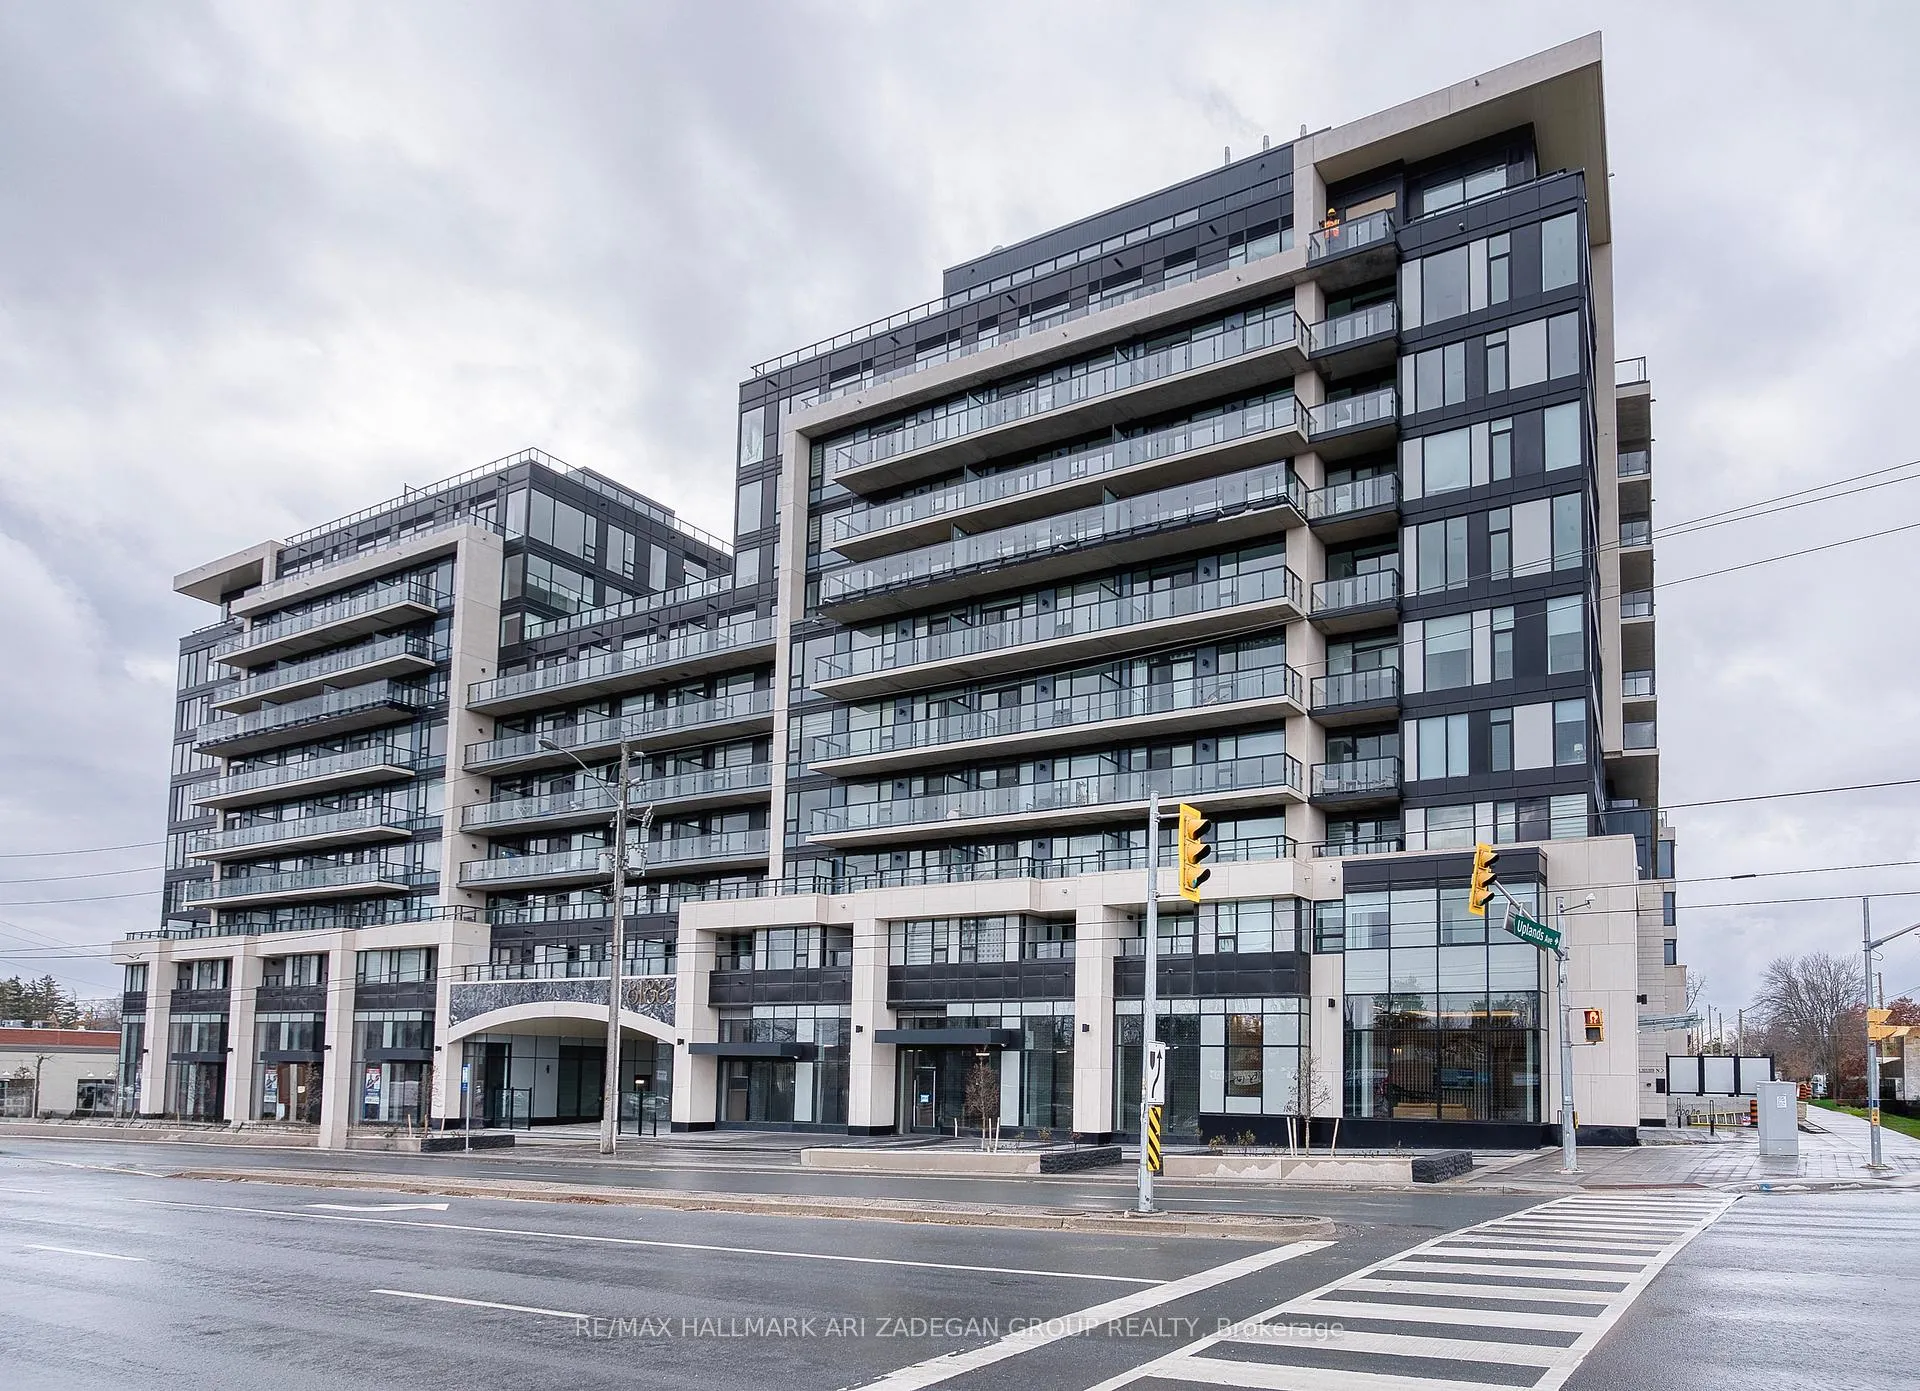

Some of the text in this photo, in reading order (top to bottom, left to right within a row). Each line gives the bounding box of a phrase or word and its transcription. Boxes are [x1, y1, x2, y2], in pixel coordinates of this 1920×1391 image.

[1517, 919, 1553, 945] Uplands Ave
[627, 979, 669, 1005] 8188
